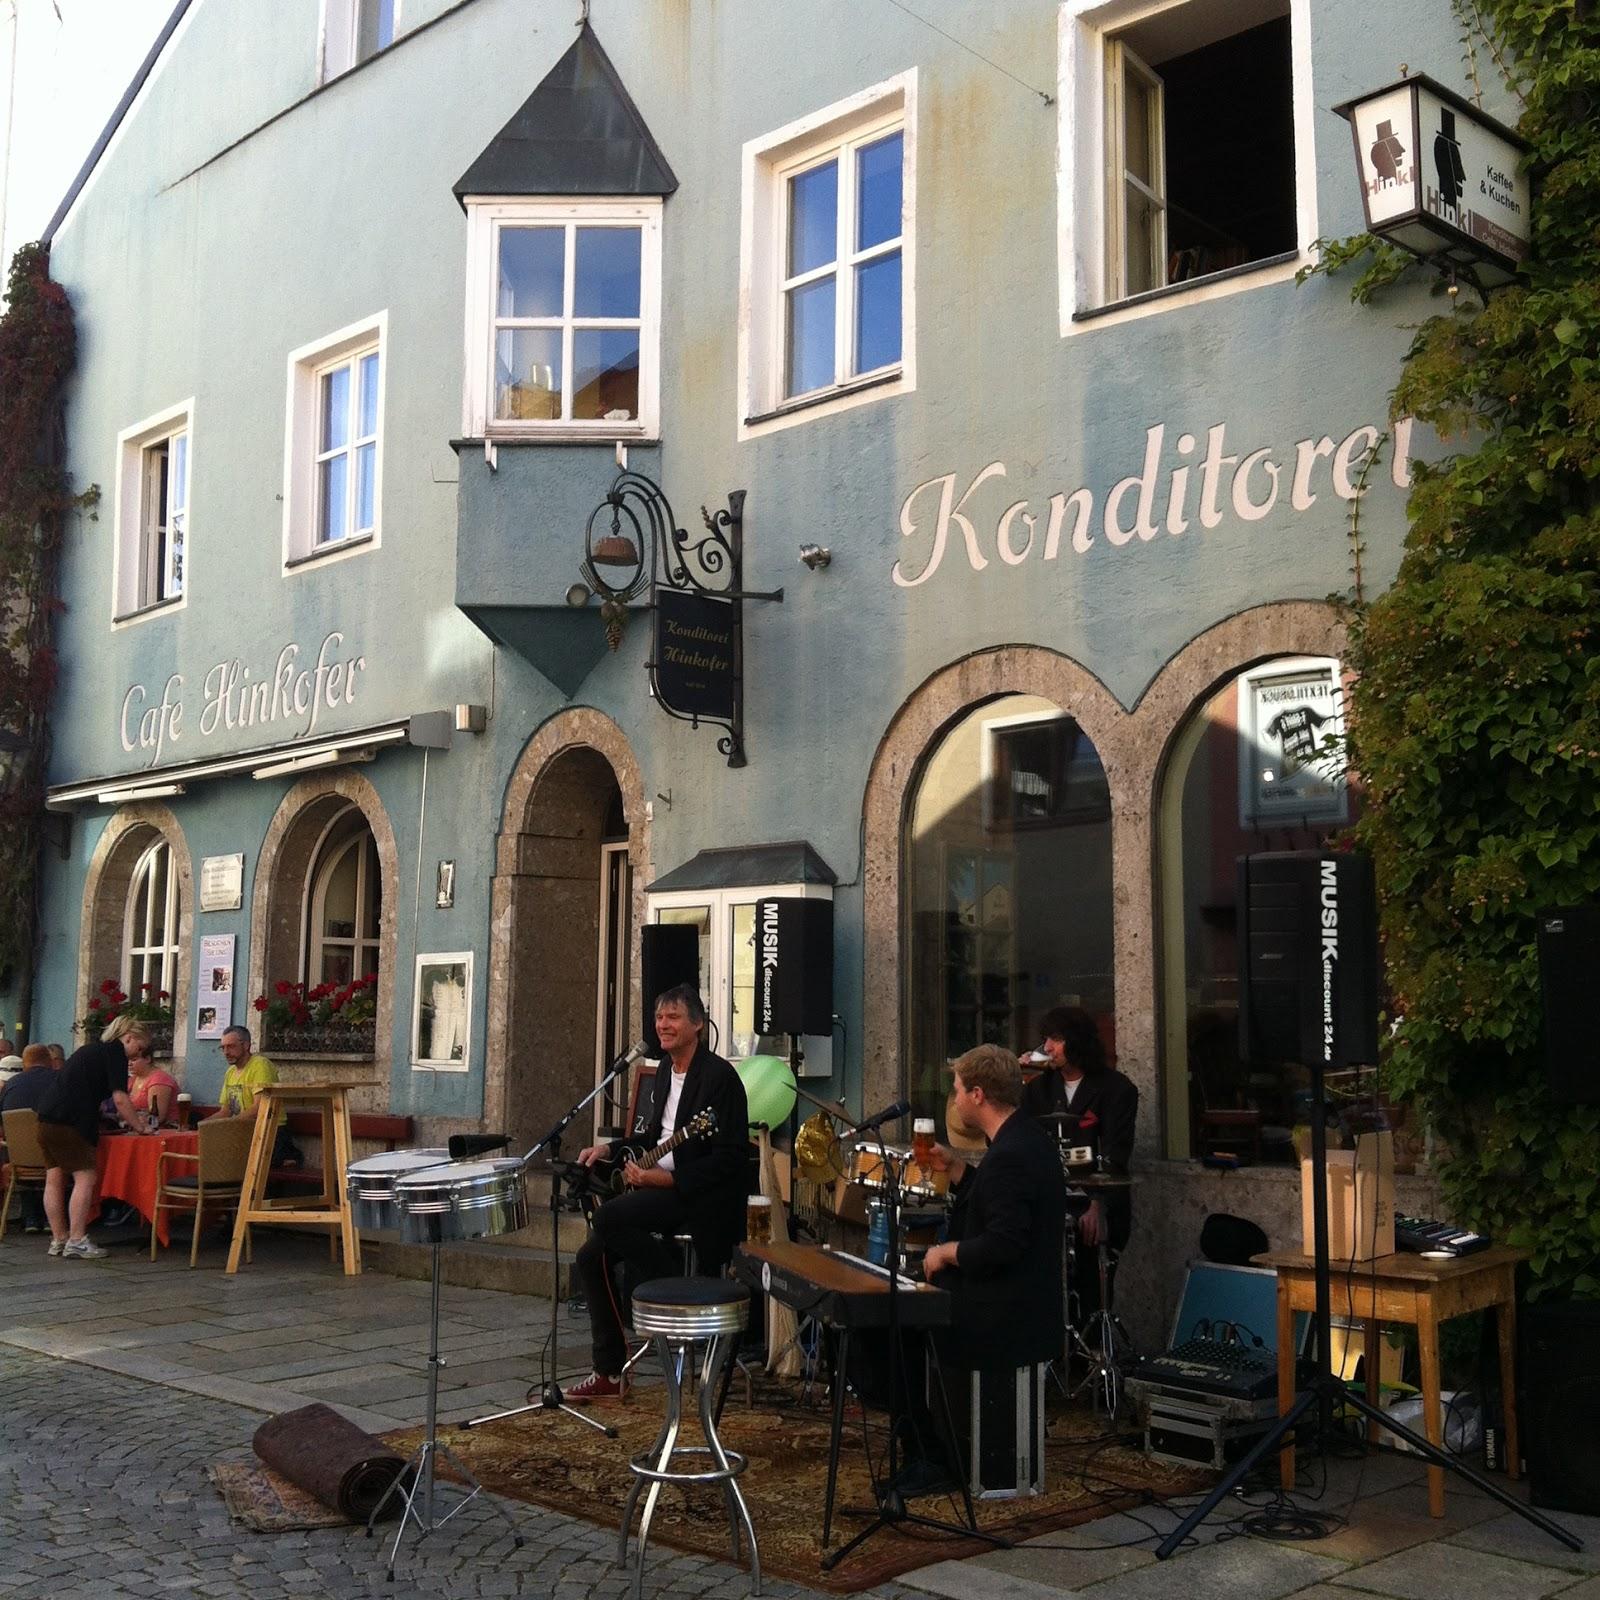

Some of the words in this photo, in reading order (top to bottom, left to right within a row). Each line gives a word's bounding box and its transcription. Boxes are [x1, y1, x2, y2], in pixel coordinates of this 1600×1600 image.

[1366, 166, 1414, 197] Hinkl
[1487, 165, 1513, 192] Kaffee
[1427, 185, 1472, 235] Hinkl
[1480, 180, 1486, 194] &
[1489, 185, 1520, 214] Kuchen
[665, 619, 729, 643] Konditorei
[664, 645, 729, 671] Hinkofer
[121, 674, 184, 768] Cafe
[200, 631, 366, 738] Hinkofer
[1486, 1429, 1495, 1459] YAMAHA
